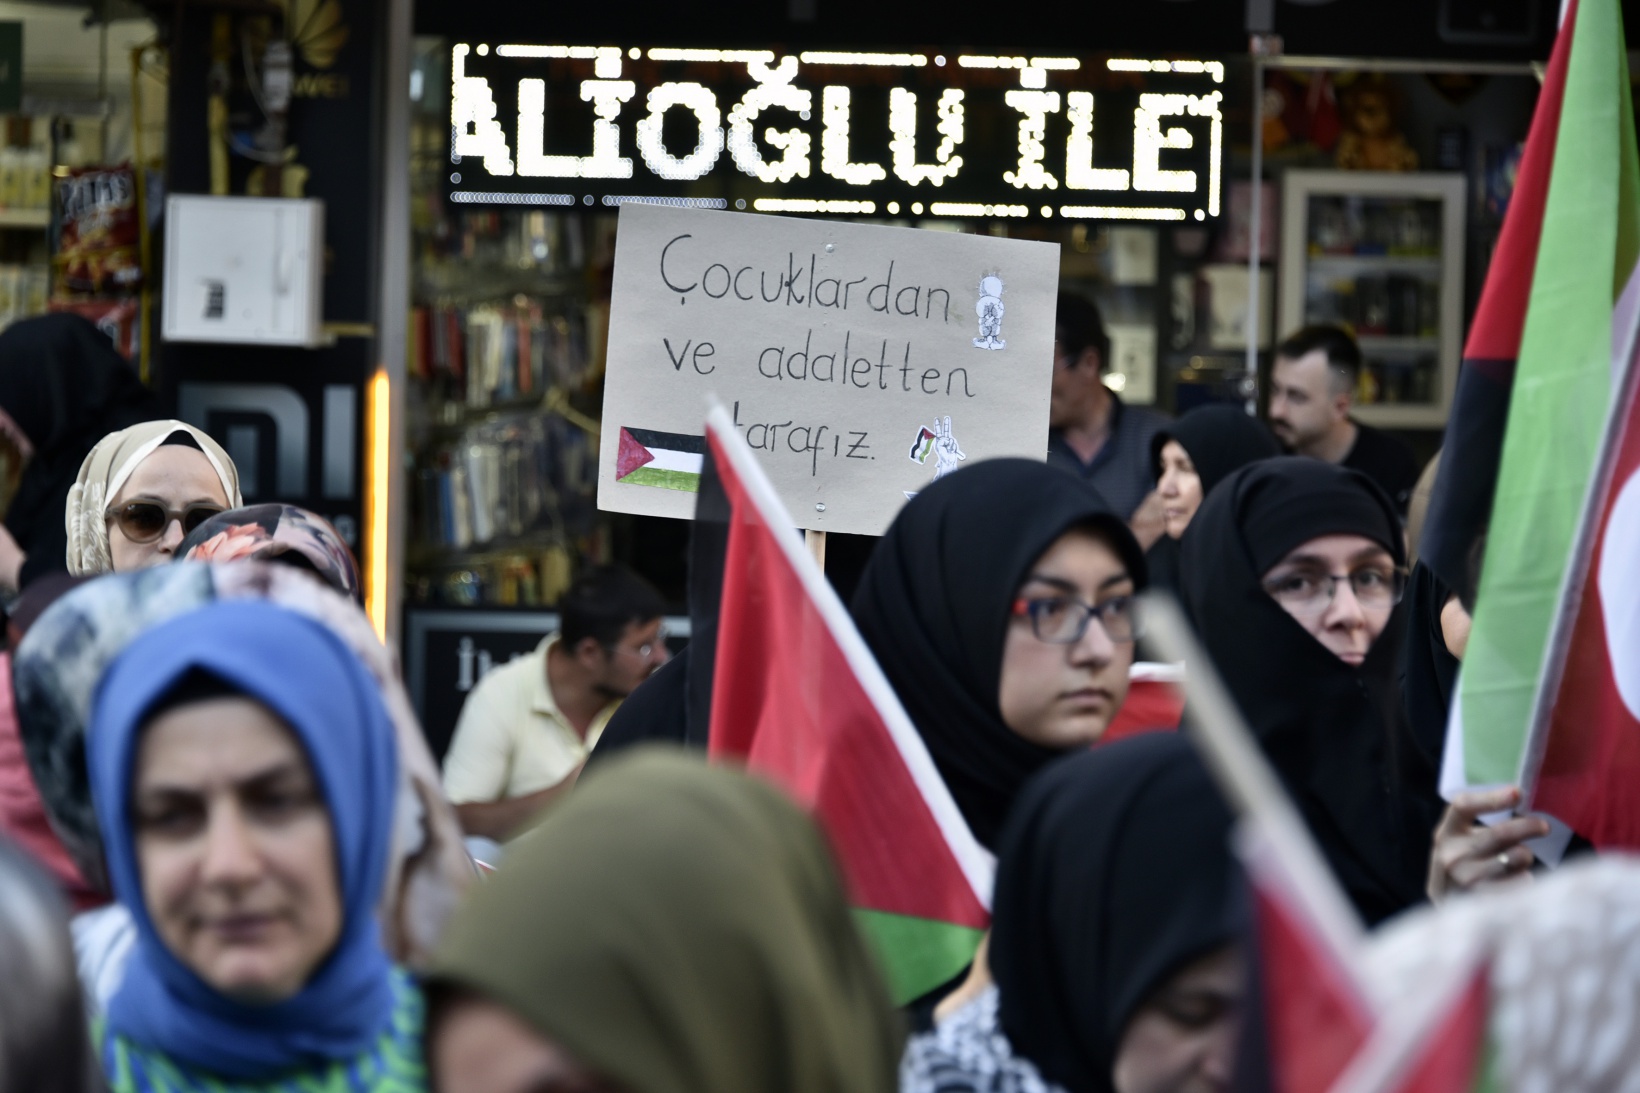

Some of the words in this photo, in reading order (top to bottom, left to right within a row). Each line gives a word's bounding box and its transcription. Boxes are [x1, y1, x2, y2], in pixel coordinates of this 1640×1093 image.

[660, 233, 951, 324] Çocuklardan
[663, 337, 717, 376] ve
[757, 328, 977, 398] adaletten
